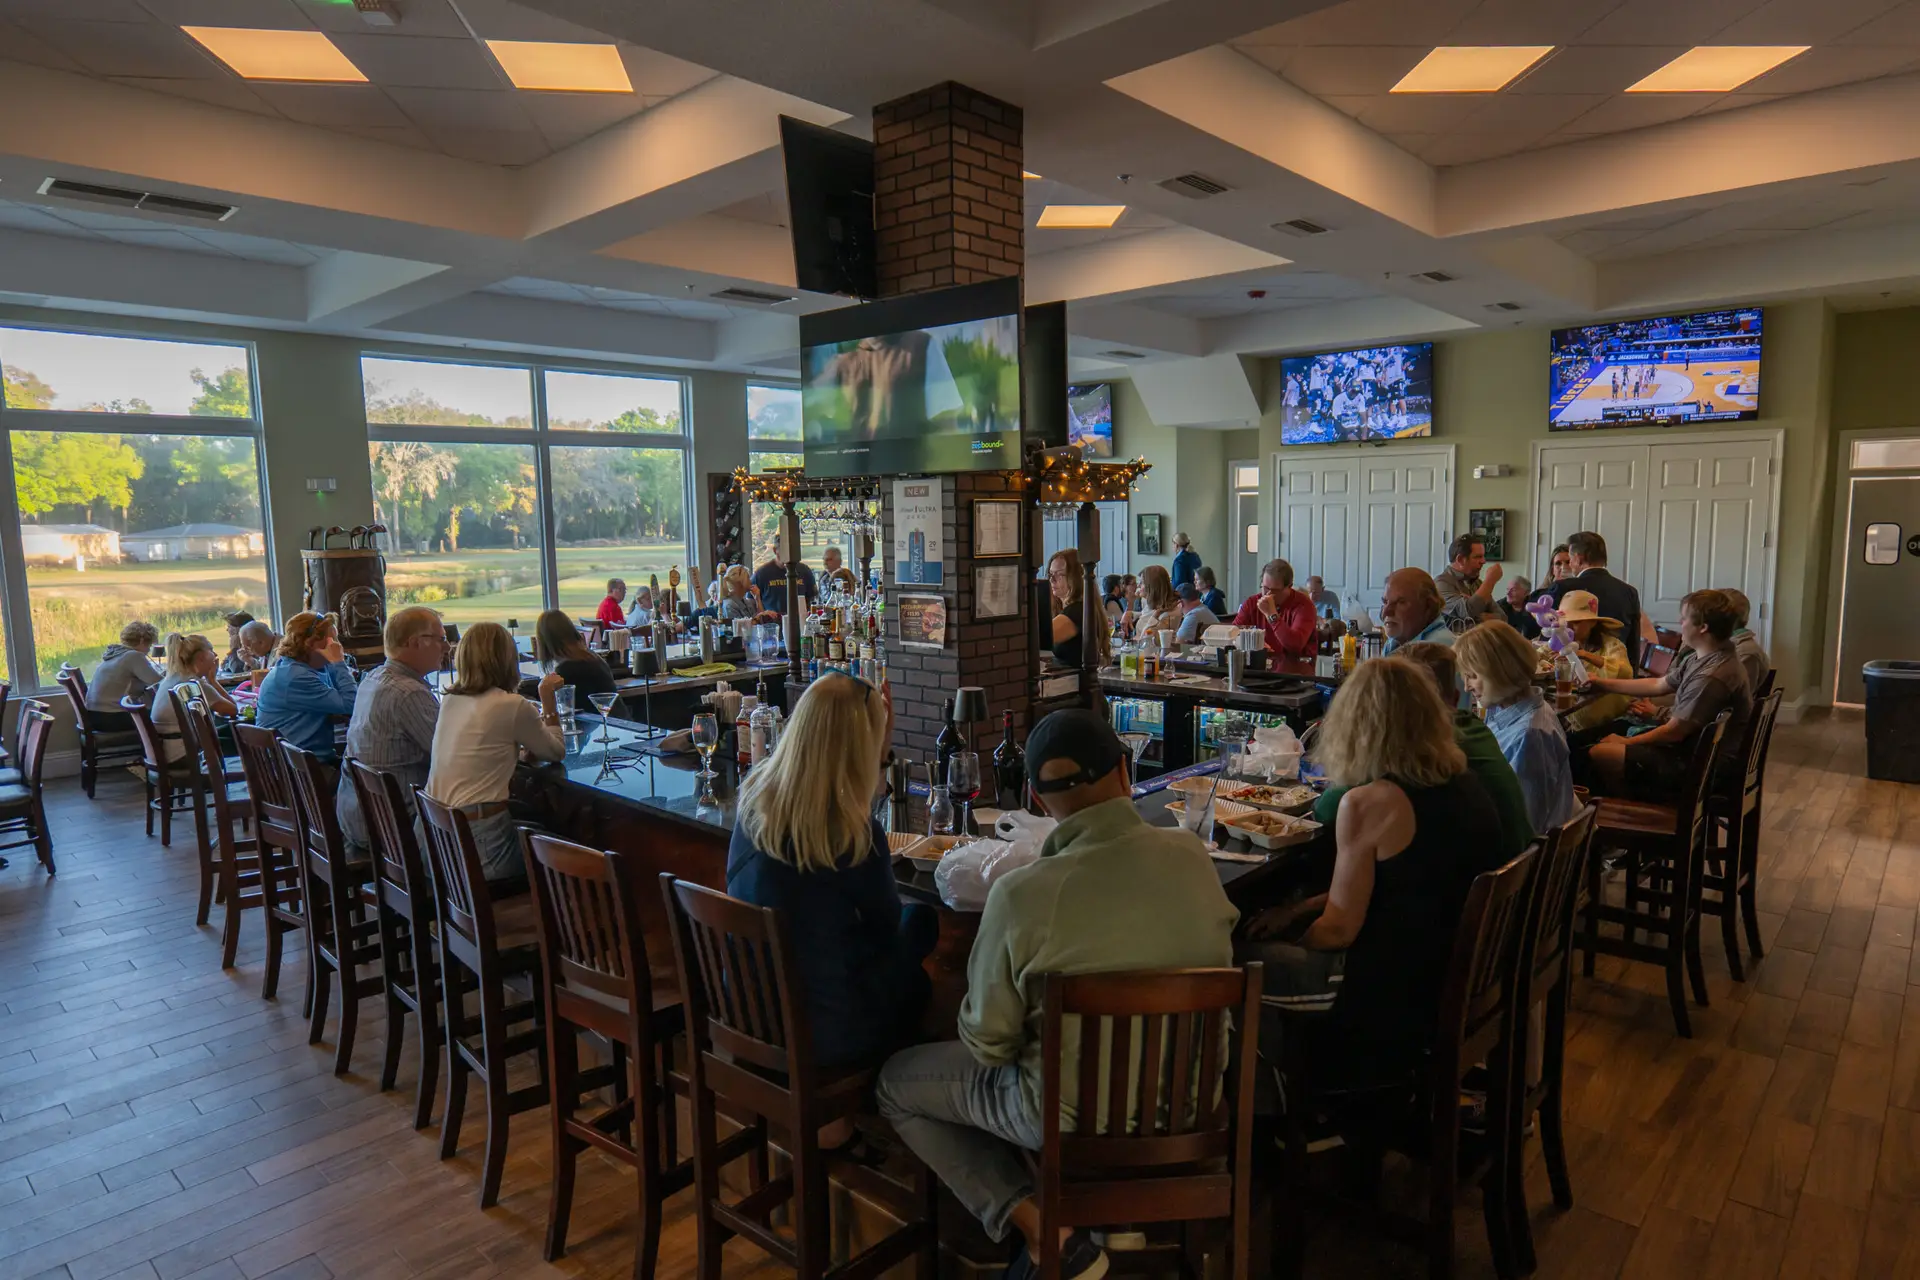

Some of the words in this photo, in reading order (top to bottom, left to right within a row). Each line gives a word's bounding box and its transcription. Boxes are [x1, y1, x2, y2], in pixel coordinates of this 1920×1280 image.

[1549, 378, 1593, 410] TIGERS
[1630, 409, 1640, 417] 36
[907, 487, 926, 496] NEW
[918, 505, 937, 513] ULTRA
[928, 540, 937, 548] 29
